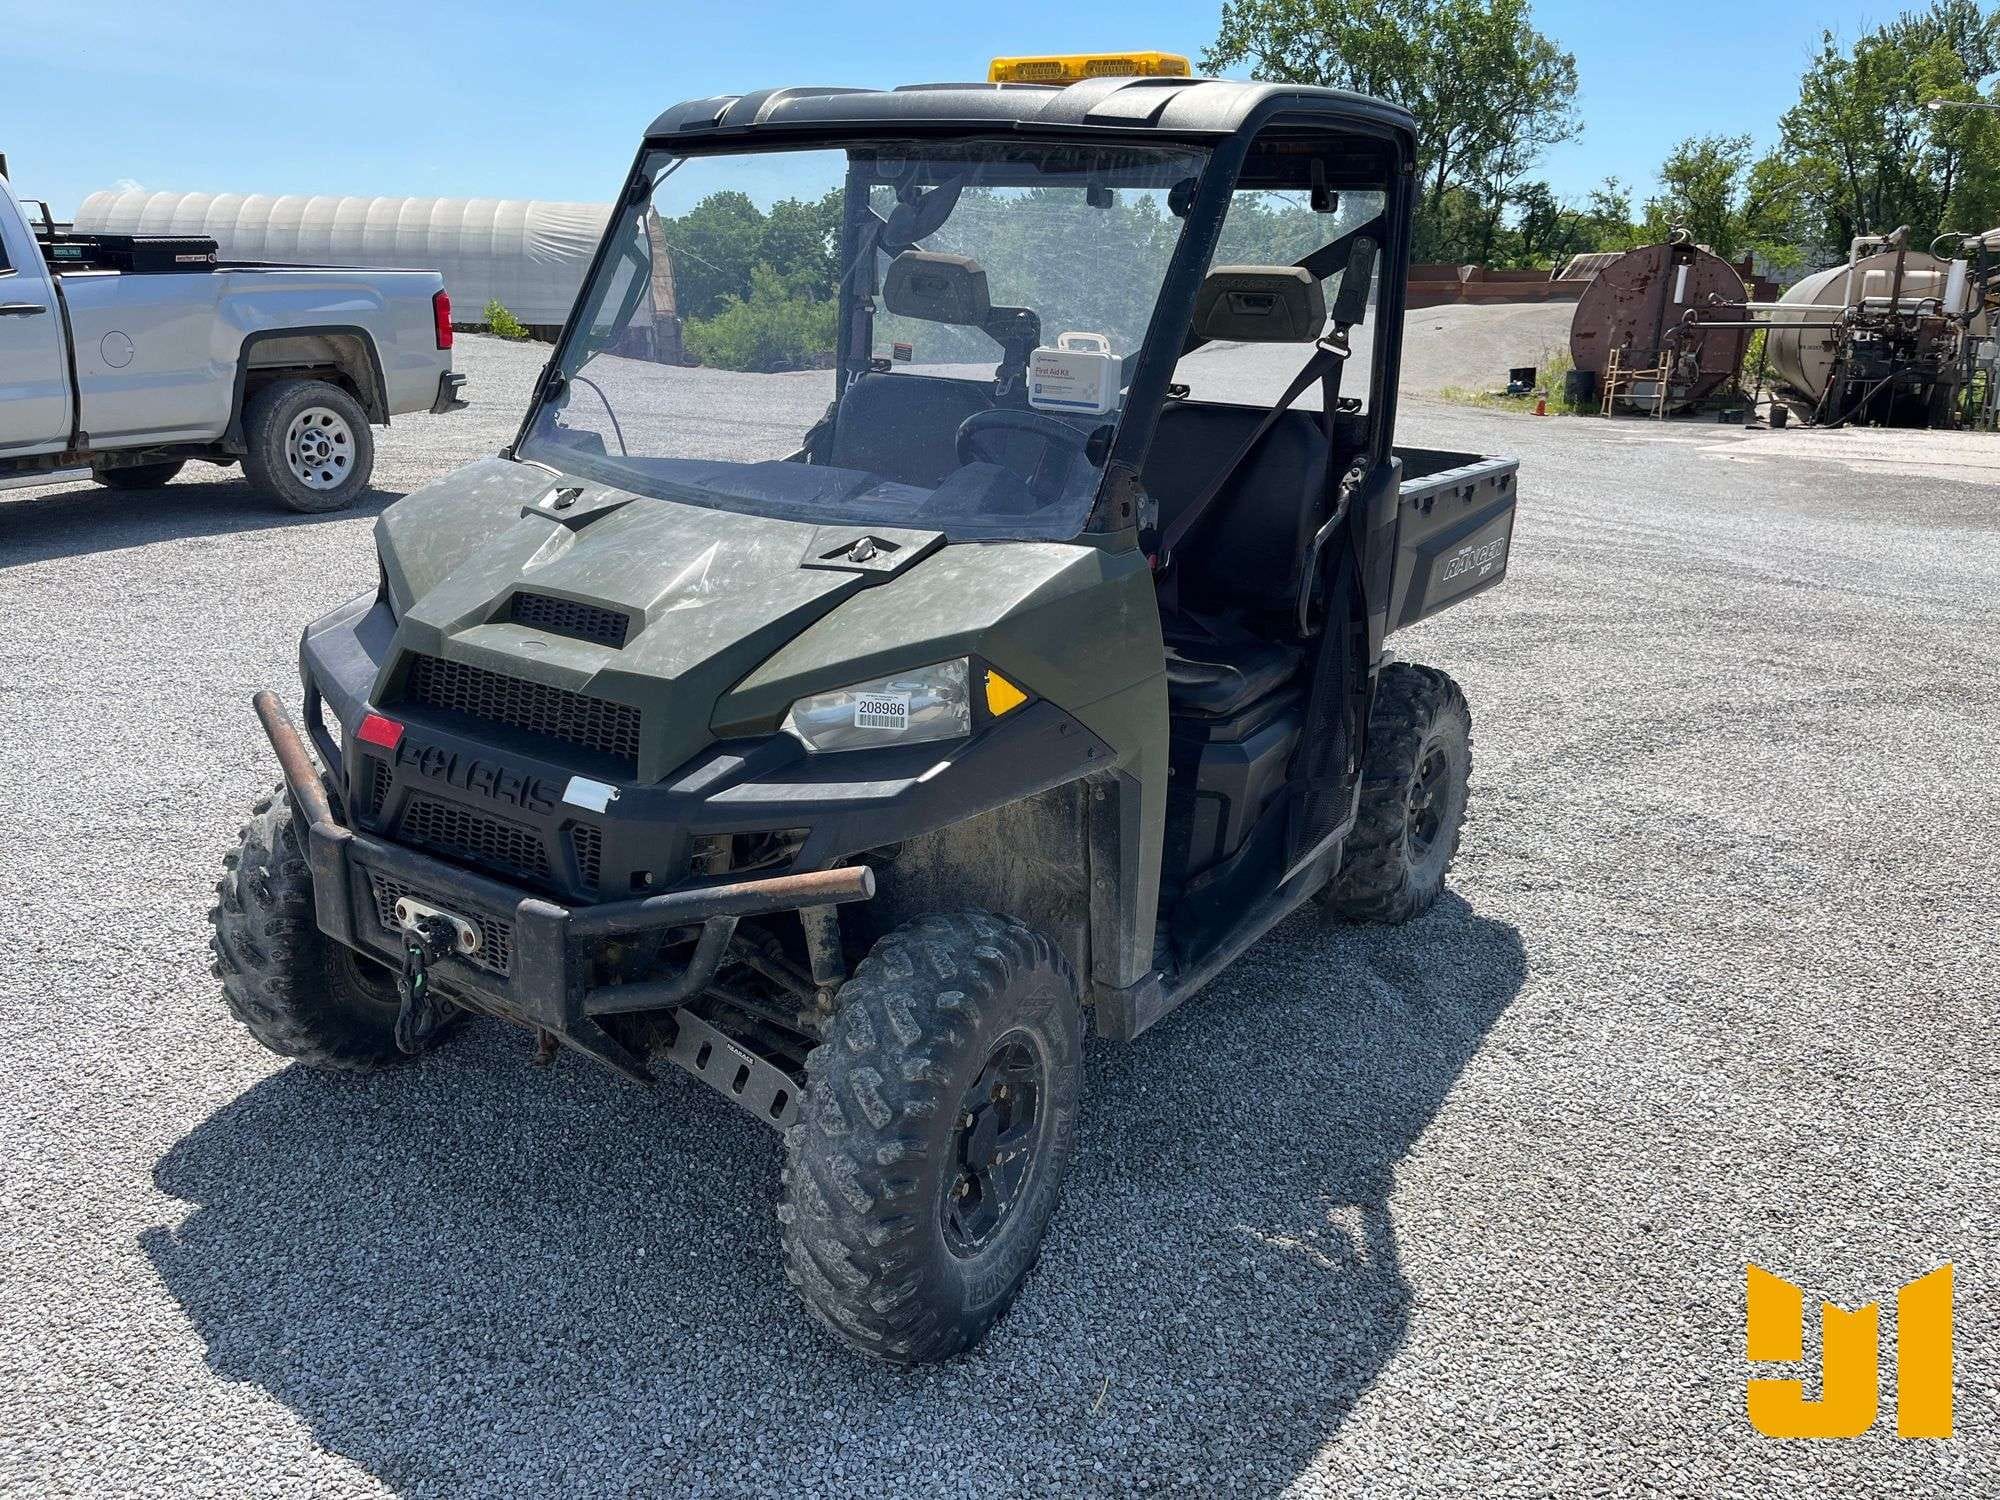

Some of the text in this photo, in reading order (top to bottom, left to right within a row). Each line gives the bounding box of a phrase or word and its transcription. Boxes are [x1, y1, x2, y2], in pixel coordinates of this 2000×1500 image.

[1036, 367, 1070, 377] First Aid Kit
[1442, 537, 1505, 581] RANGER
[1479, 563, 1492, 577] XP
[859, 700, 905, 716] 208986
[395, 737, 556, 816] POLARIS
